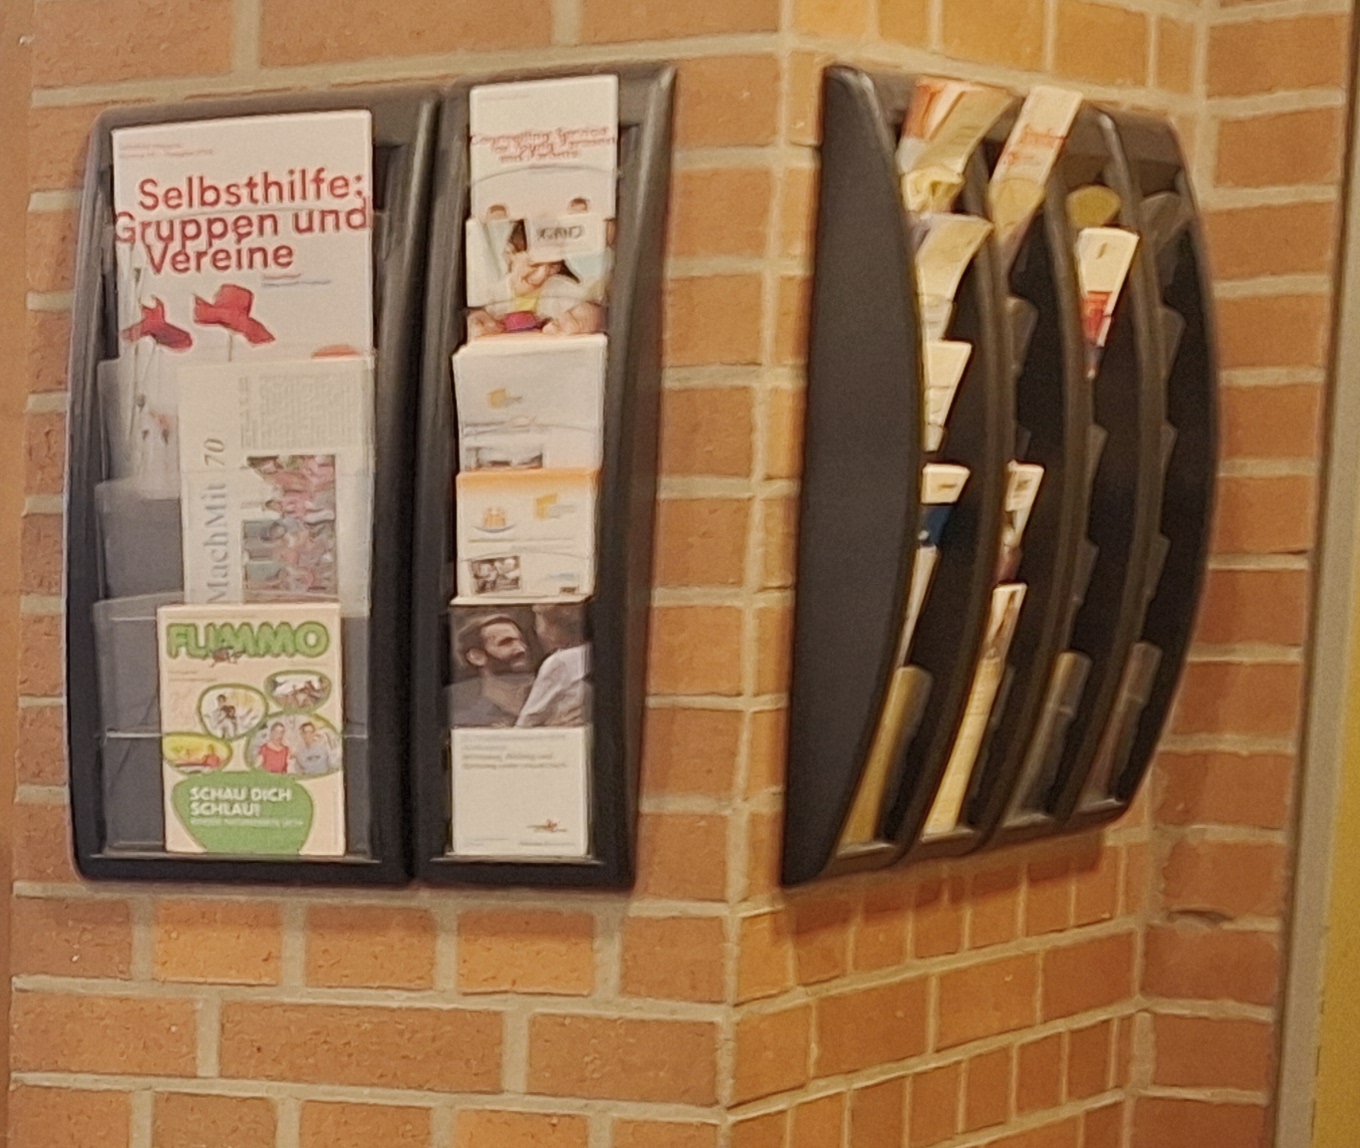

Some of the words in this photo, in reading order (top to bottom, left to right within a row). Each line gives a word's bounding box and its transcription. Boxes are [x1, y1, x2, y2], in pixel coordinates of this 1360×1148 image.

[138, 167, 364, 210] Selbsthilfe:
[116, 210, 279, 251] Gruppen
[293, 196, 370, 234] und
[144, 240, 295, 274] Vereine
[203, 437, 226, 467] 70
[190, 787, 247, 801] SCHAU
[250, 788, 293, 802] DICH
[190, 802, 261, 817] SCHLAU!
